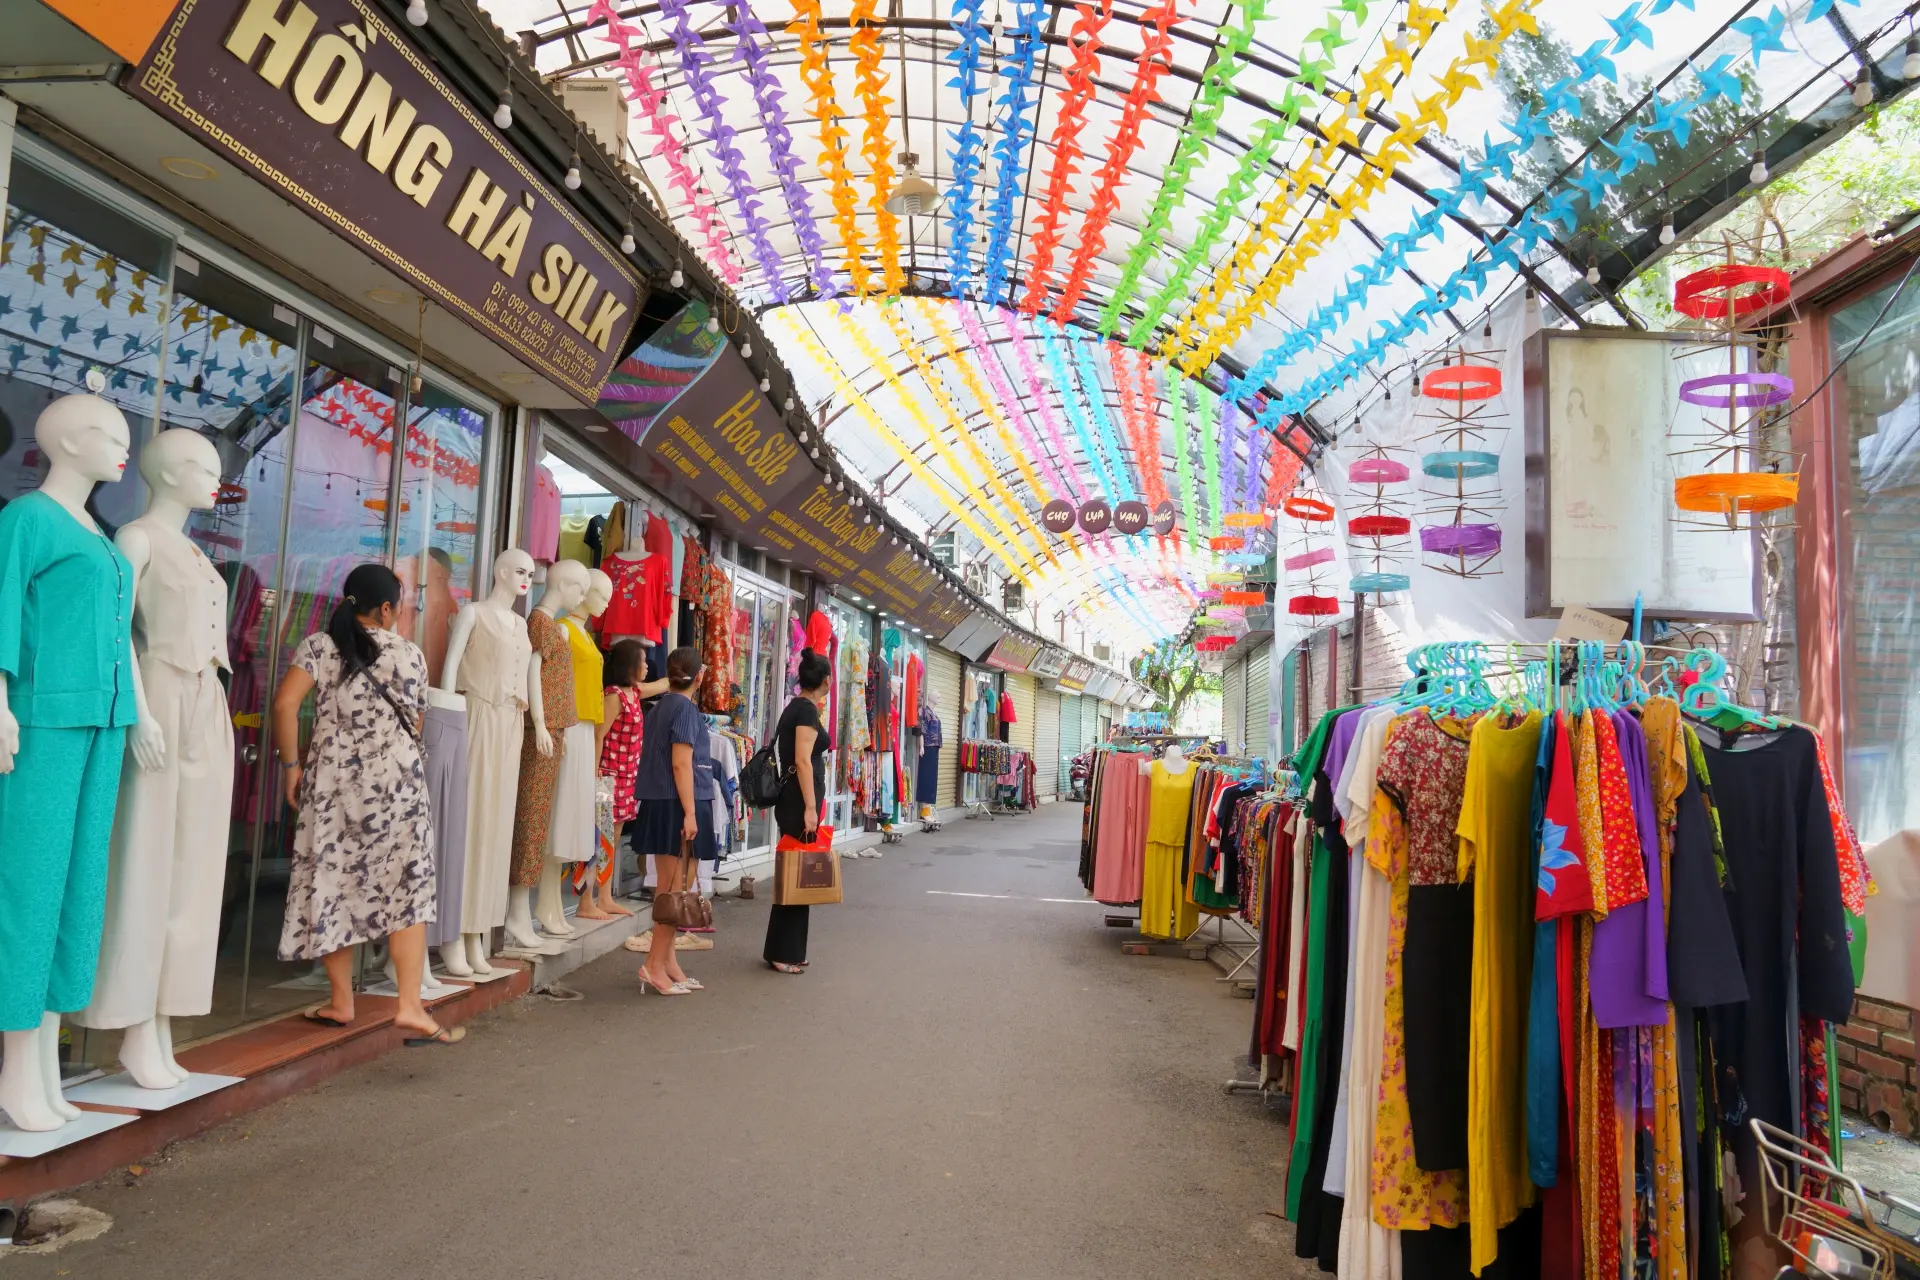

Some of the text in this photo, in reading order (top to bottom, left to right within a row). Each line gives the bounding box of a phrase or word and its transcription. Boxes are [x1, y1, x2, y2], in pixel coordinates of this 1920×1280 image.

[224, 0, 627, 353] HỒNG HÀ SILK
[482, 297, 500, 317] NR:
[499, 309, 522, 333] 0433
[520, 326, 548, 352] 828273
[552, 349, 569, 369] 0433
[568, 361, 581, 376] 517
[577, 367, 592, 385] 770
[491, 281, 508, 301] ĐT:
[507, 294, 529, 316] 0987
[527, 310, 542, 326] 421
[541, 319, 555, 337] 985
[559, 335, 576, 355] 0904
[574, 346, 588, 362] 102
[584, 355, 598, 371] 206
[713, 388, 761, 455] Hoa
[745, 432, 798, 486] Silk
[849, 525, 883, 554] Silk
[1119, 511, 1140, 524] VẠN
